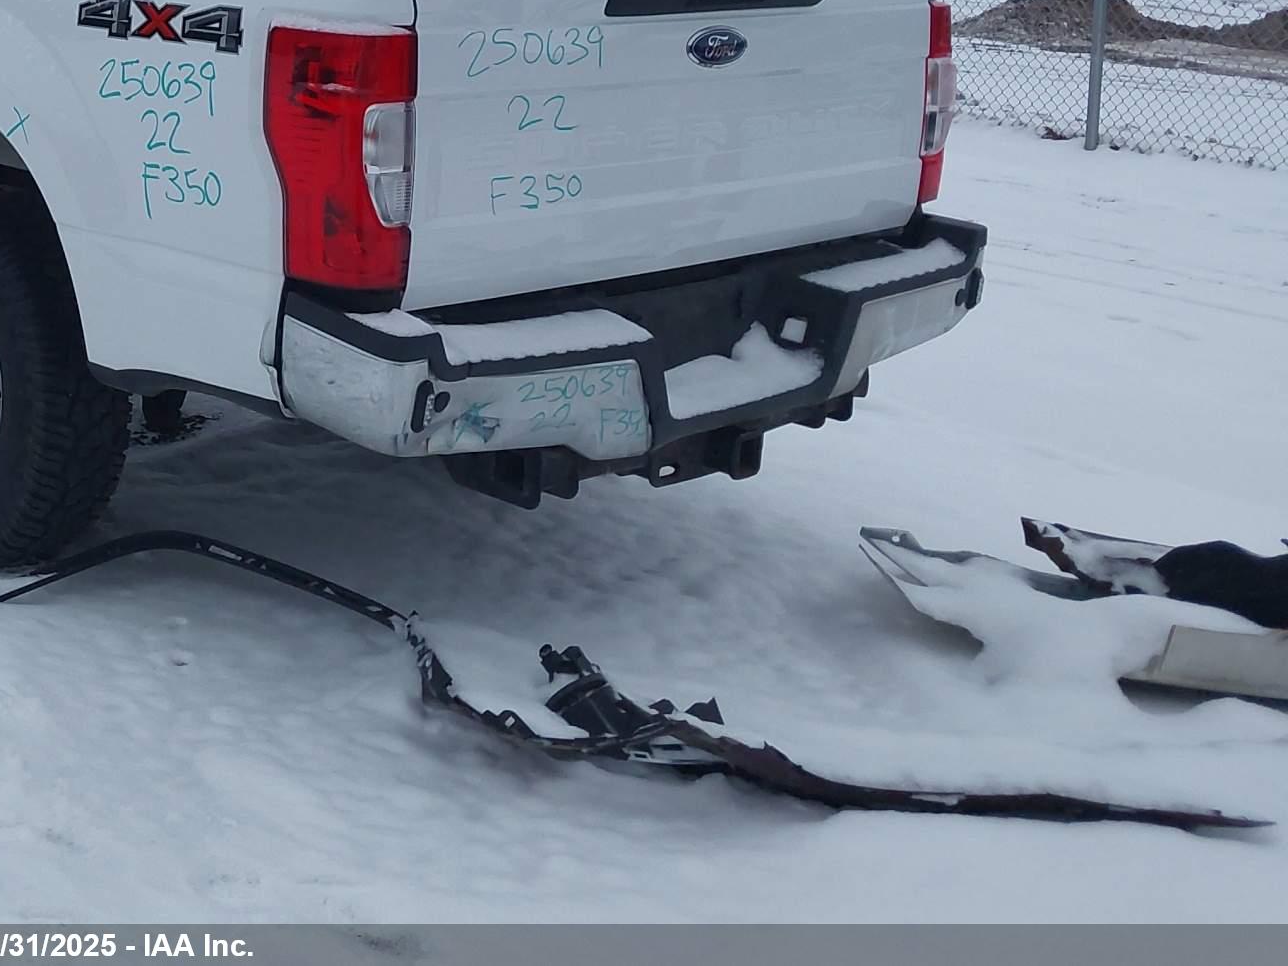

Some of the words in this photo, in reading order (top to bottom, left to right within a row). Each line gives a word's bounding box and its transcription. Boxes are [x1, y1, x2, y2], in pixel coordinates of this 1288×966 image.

[458, 26, 604, 77] 250639
[705, 35, 737, 59] Ford
[99, 59, 215, 116] 250639
[141, 110, 191, 154] 22
[508, 95, 579, 131] 22
[142, 162, 221, 219] F350
[491, 174, 583, 215] F350
[517, 365, 630, 403] 250639
[529, 403, 576, 432] 22
